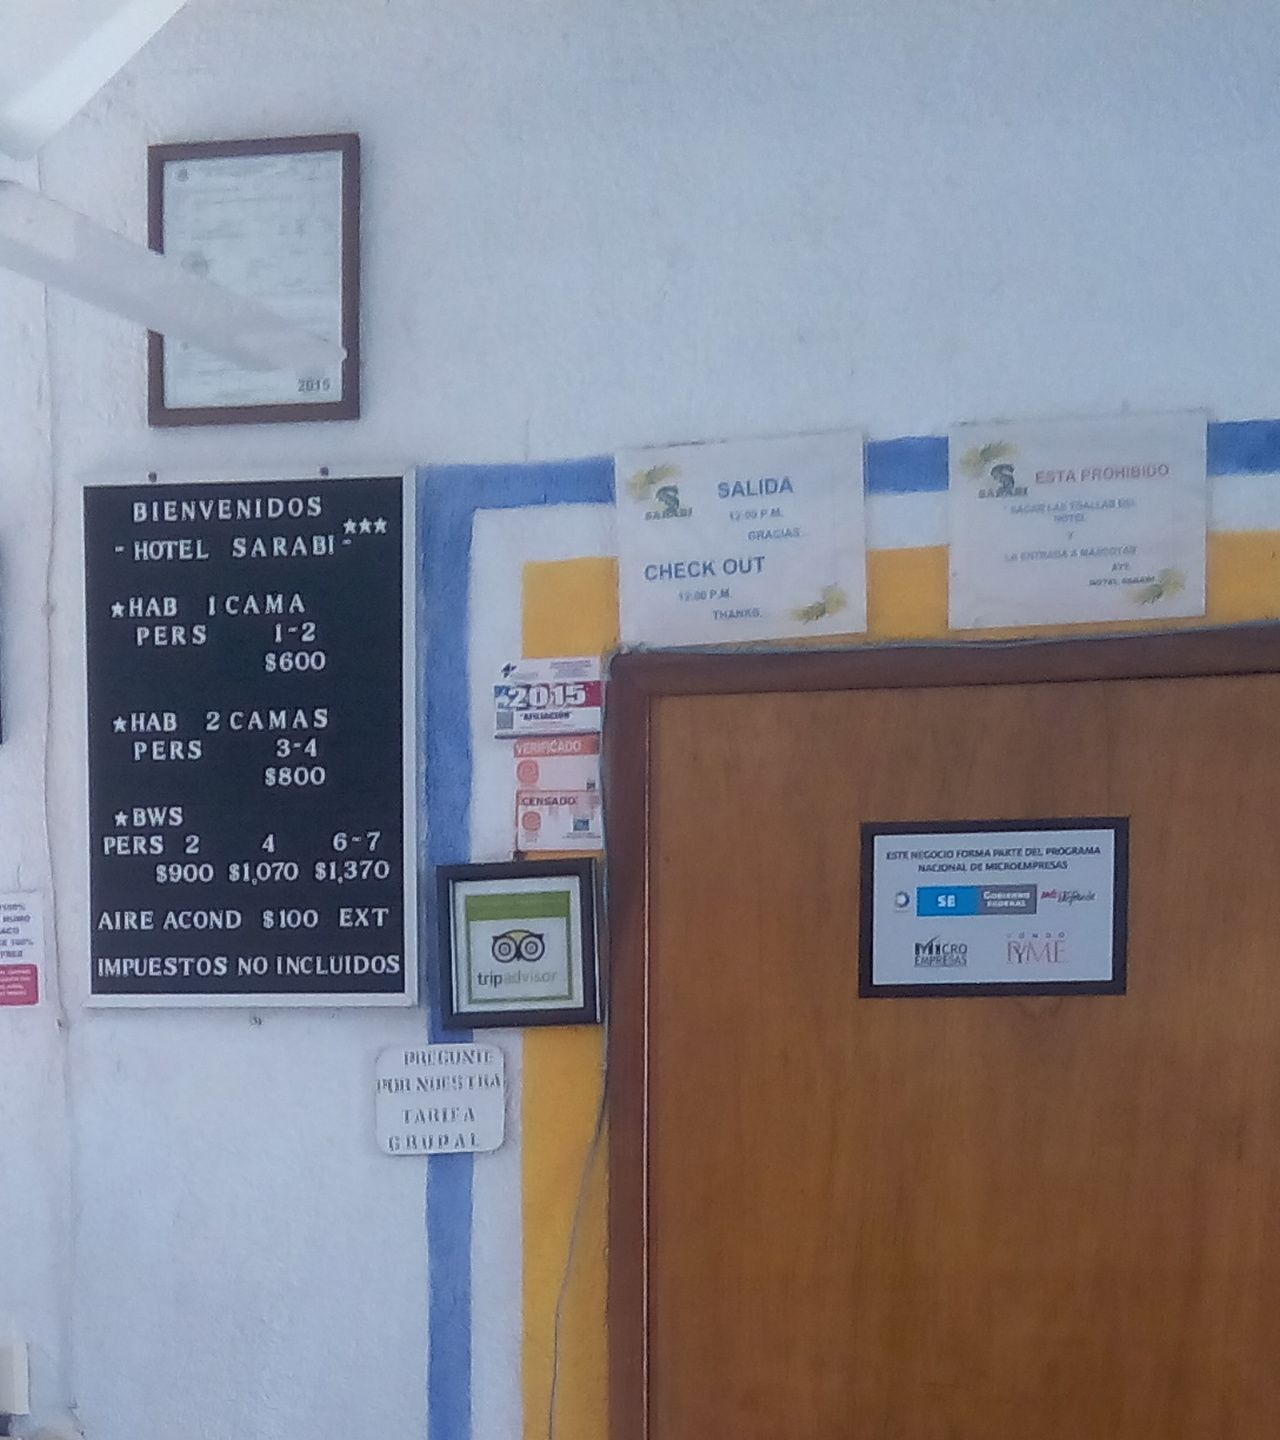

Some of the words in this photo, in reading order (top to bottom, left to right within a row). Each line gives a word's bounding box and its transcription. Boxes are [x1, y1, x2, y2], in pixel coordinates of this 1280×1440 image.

[1035, 470, 1076, 485] ESTA
[1080, 464, 1170, 482] PROHIBIDO
[717, 476, 793, 499] SALIDA
[133, 497, 322, 522] BIENVENIDOS
[134, 540, 209, 561] HOTEL
[232, 535, 335, 558] SARABI
[644, 561, 715, 582] CHECK
[723, 556, 766, 575] OUT
[128, 597, 178, 617] HAB
[225, 593, 305, 615] CAMA
[136, 625, 207, 646] PERS
[274, 622, 317, 642] 1-2
[264, 651, 326, 672] $600
[507, 684, 586, 709] 2015
[131, 713, 177, 732] HAB
[206, 711, 221, 731] 2
[229, 708, 328, 731] CAMAS
[134, 740, 202, 761] PERS
[276, 738, 317, 758] 3-4
[264, 766, 326, 786] $800
[132, 807, 183, 827] BWS
[103, 836, 163, 855] PERS
[185, 835, 200, 854] 2
[261, 834, 275, 853] 4
[911, 850, 954, 860] NEGOCIO
[956, 848, 991, 858] FORMA
[993, 847, 1023, 857] PARTE
[1045, 846, 1101, 856] PROGRAMA
[156, 863, 214, 883] $900
[228, 862, 299, 885] $1,070
[314, 860, 390, 884] $1,370
[918, 863, 967, 873] NACIONAL
[985, 860, 1068, 871] MICROEMPRESAS
[97, 911, 154, 931] AIRE
[163, 910, 242, 930] ACOND
[263, 909, 319, 929] $100
[339, 908, 389, 928] EXT
[97, 957, 228, 977] IMPUESTOS
[237, 956, 268, 976] NO
[276, 954, 400, 975] INCLUIDOS
[477, 970, 558, 988] tripadvisor
[402, 1107, 475, 1124] TARIFA
[389, 1132, 479, 1151] GRUPAL
